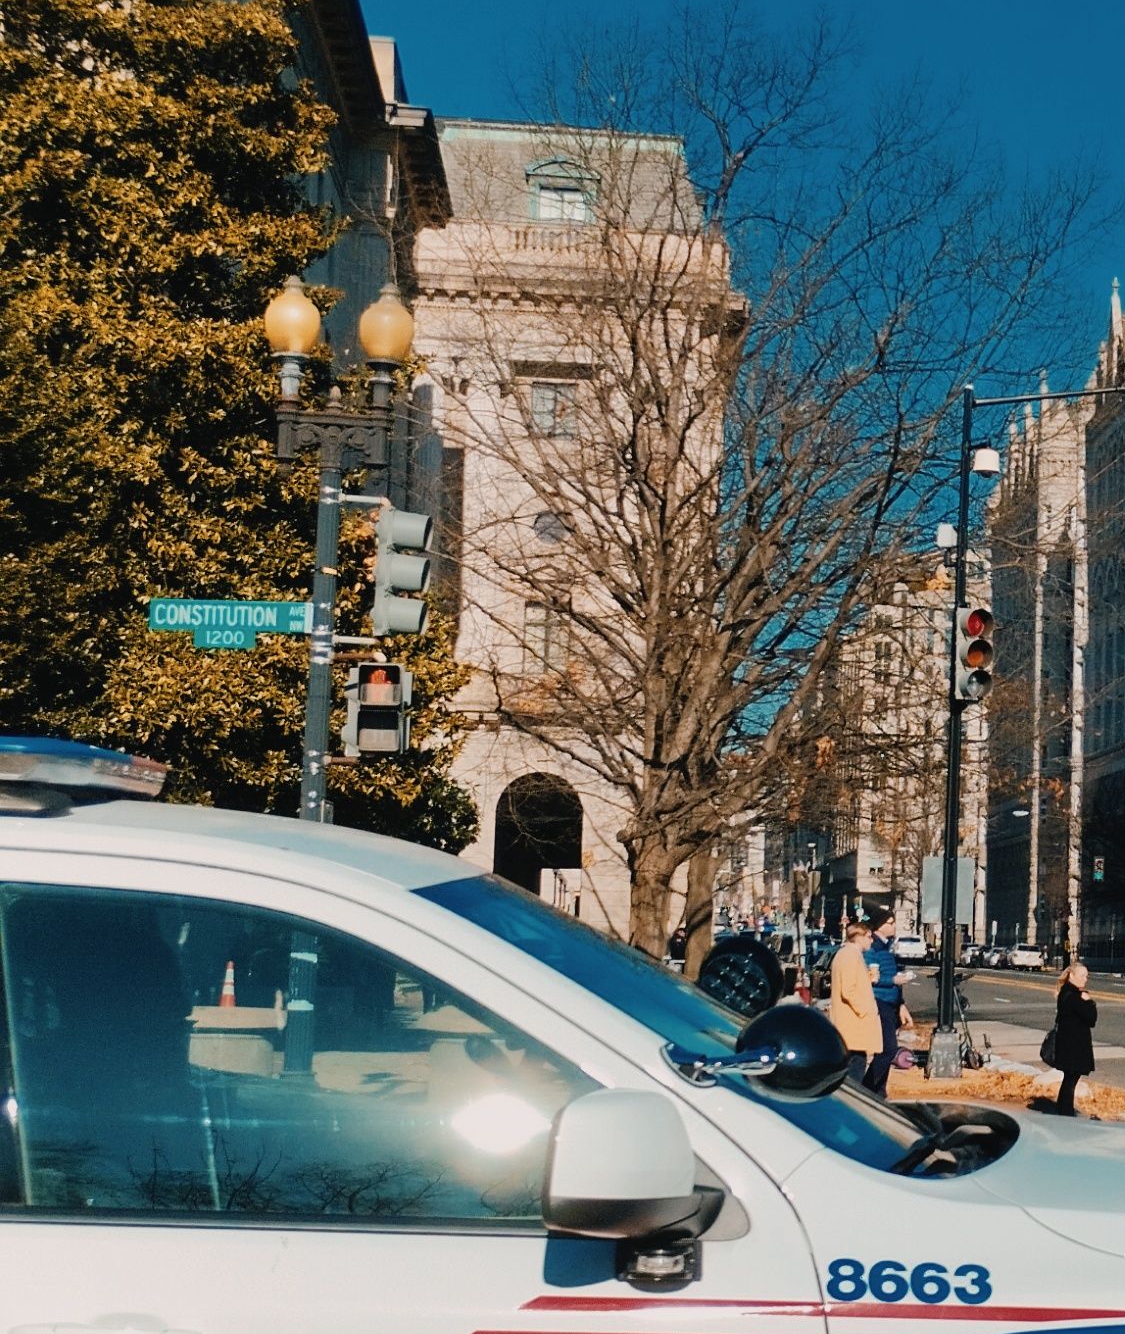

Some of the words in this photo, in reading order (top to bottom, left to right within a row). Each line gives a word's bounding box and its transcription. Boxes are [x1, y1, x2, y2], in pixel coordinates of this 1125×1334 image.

[155, 603, 277, 627] CONSTITUTION
[289, 606, 305, 617] AVE
[289, 620, 304, 632] NW
[206, 630, 245, 645] 1200
[826, 1258, 993, 1305] 8663
